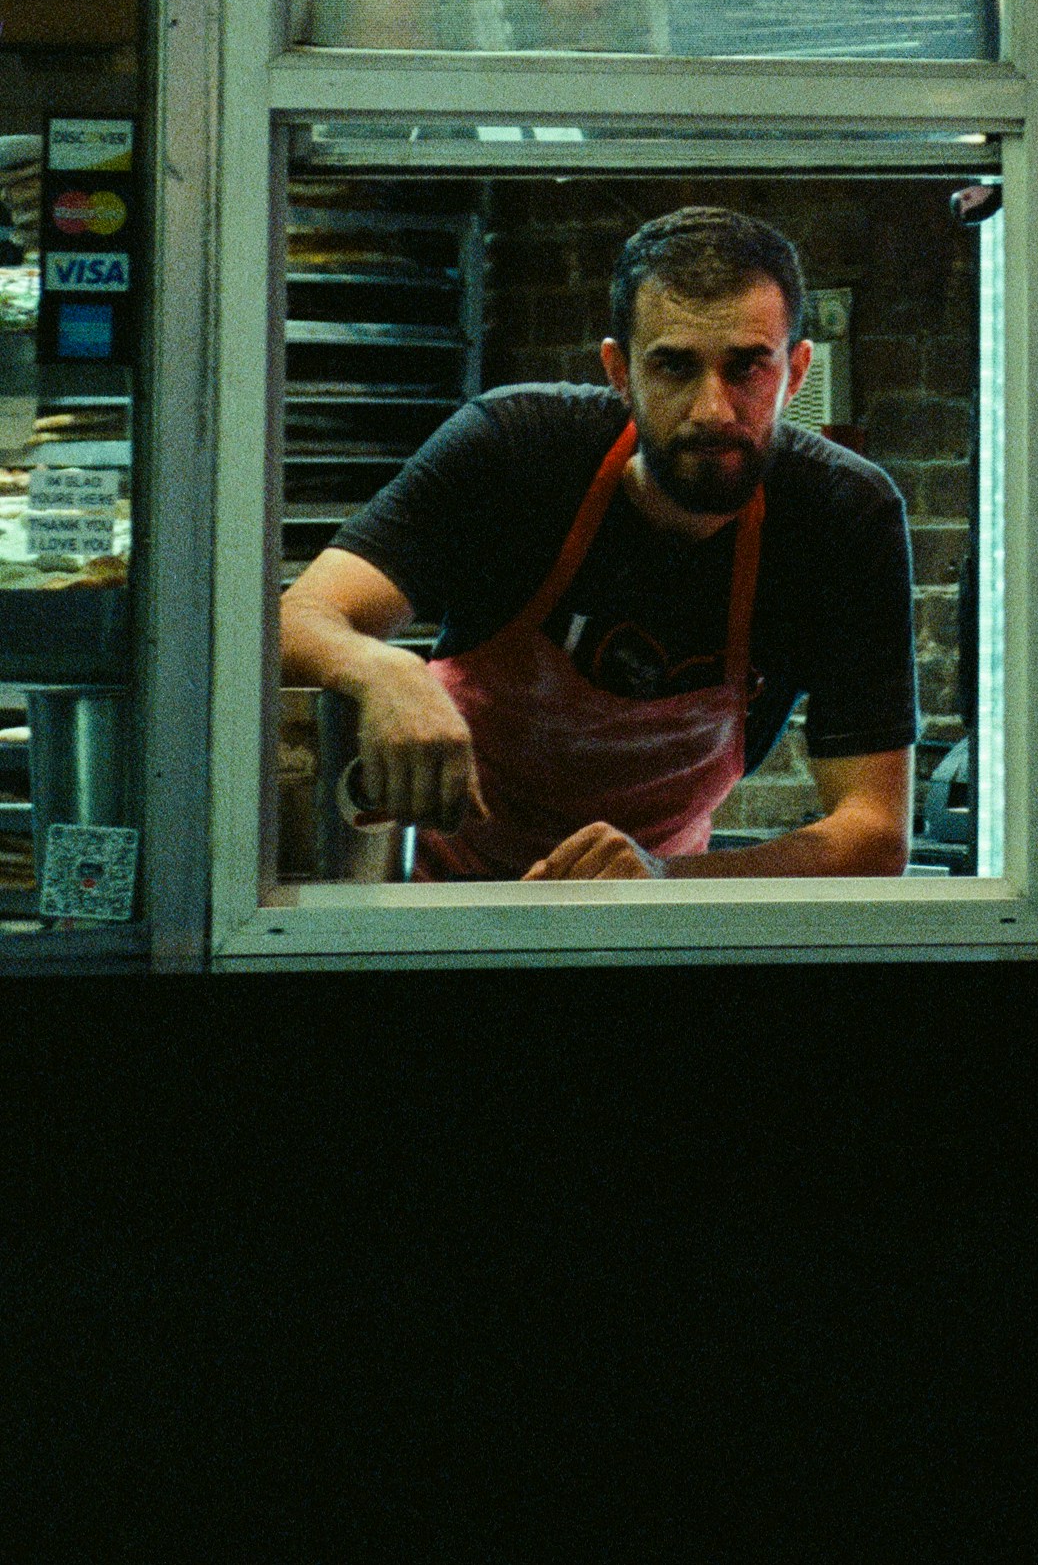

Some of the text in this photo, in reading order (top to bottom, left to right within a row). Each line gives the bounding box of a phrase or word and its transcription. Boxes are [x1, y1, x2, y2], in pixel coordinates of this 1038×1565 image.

[54, 259, 124, 284] VISA
[29, 518, 113, 532] THANK YOU
[39, 538, 76, 551] LOVE
[84, 538, 111, 551] YOU
